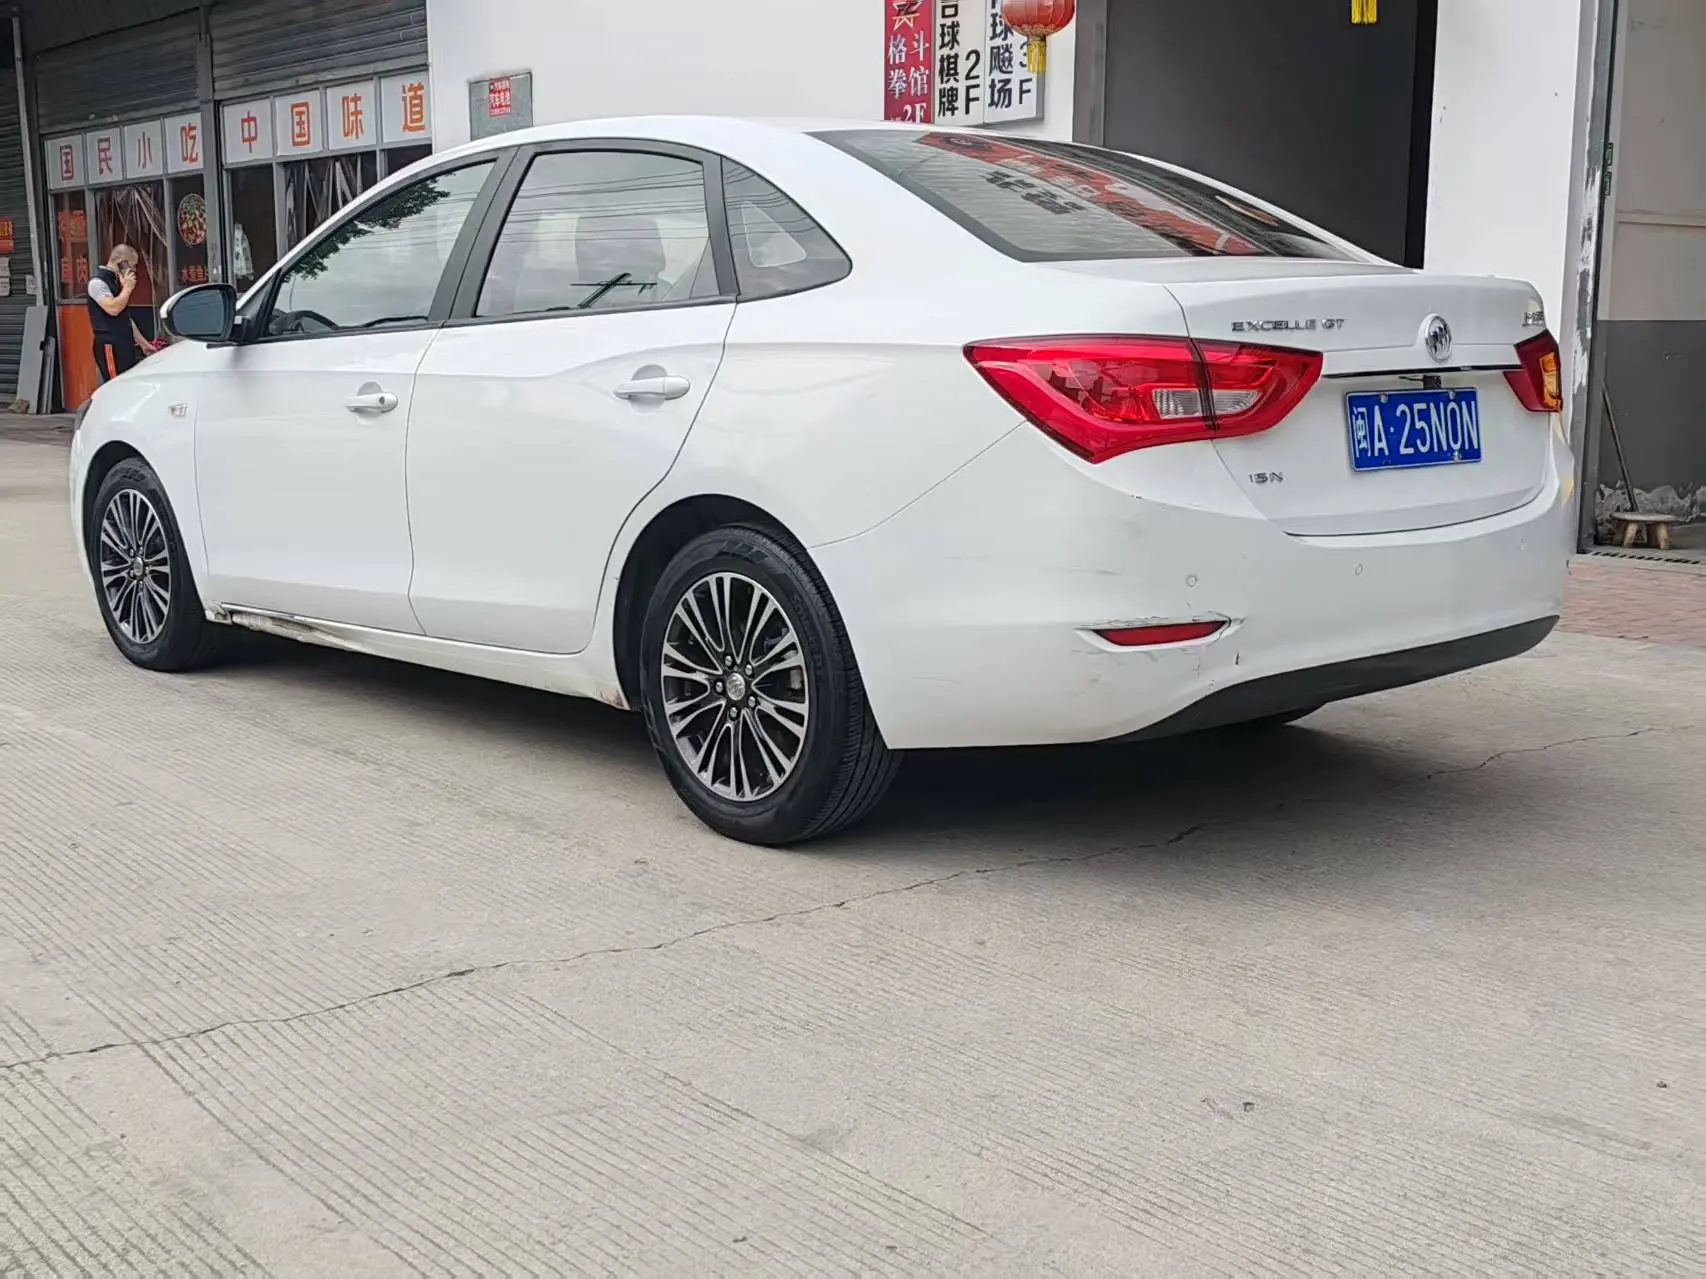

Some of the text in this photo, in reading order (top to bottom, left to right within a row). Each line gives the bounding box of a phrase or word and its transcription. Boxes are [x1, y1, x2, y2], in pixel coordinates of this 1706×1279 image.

[987, 0, 1014, 109] 球飚场
[240, 81, 426, 153] 中国味道
[903, 102, 928, 124] 2F
[59, 122, 199, 181] 国民小吃
[1231, 318, 1345, 333] EXCELLE GT
